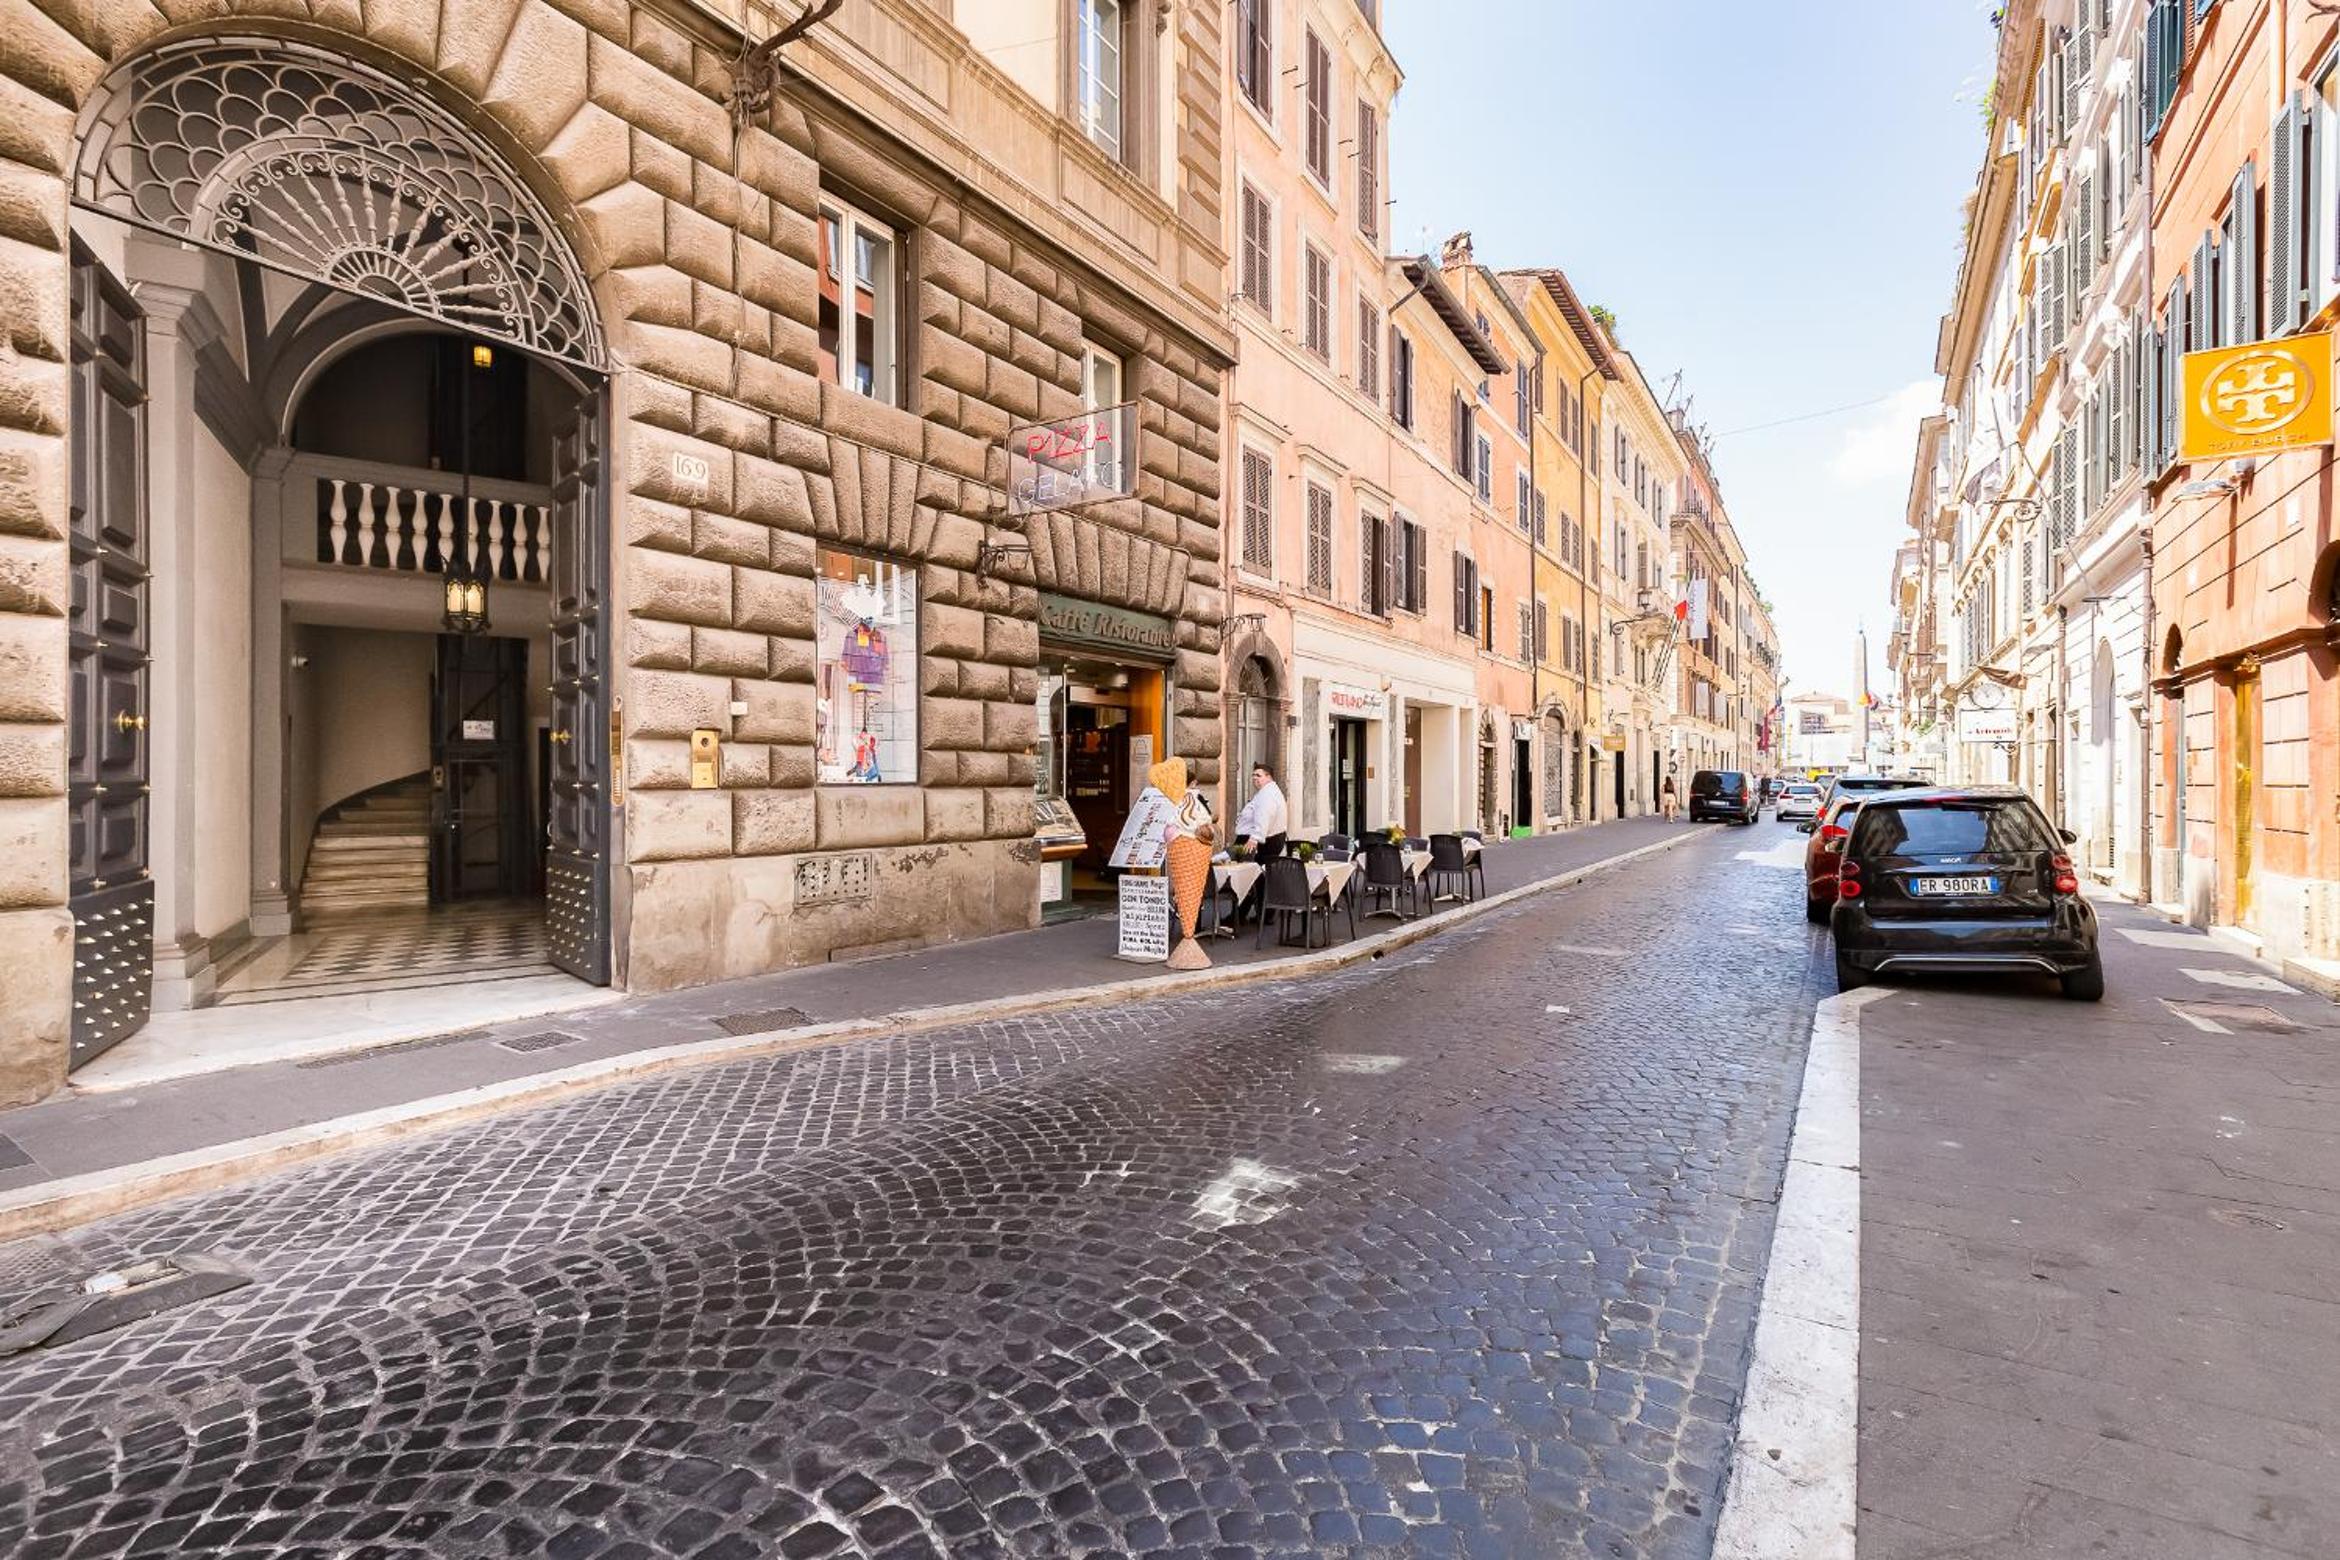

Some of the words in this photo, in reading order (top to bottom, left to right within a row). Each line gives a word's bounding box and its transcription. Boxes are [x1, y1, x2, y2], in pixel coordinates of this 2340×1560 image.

[1026, 422, 1113, 463] PIZZA
[676, 455, 706, 479] 169
[1018, 461, 1123, 502] GELATO
[1920, 879, 1937, 891] ER
